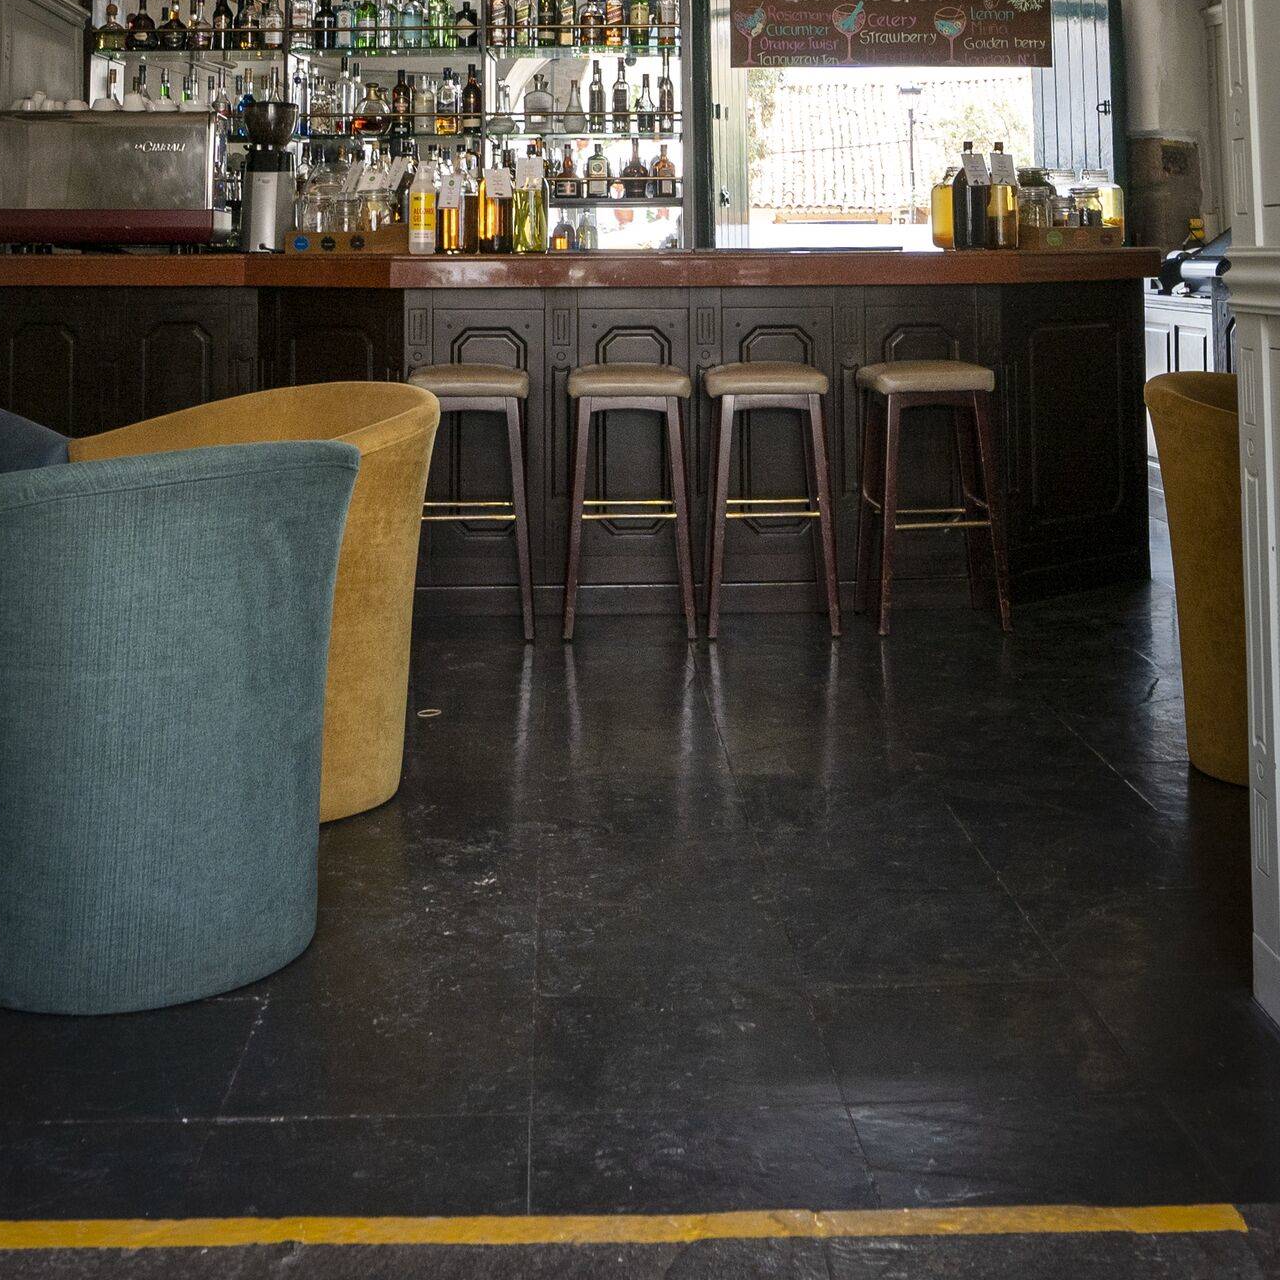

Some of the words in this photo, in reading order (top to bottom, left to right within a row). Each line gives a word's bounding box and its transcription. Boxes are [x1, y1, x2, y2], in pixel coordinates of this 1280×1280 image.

[868, 13, 917, 28] Celery
[970, 7, 1014, 21] Lemon
[766, 24, 830, 37] Cucumber
[860, 30, 937, 45] Strawberry
[760, 37, 806, 52] Orange
[808, 37, 838, 51] Twist
[963, 37, 1009, 50] Golden
[1014, 37, 1046, 50] berry
[757, 51, 821, 66] Tanqueray
[142, 141, 186, 152] CIMBALI
